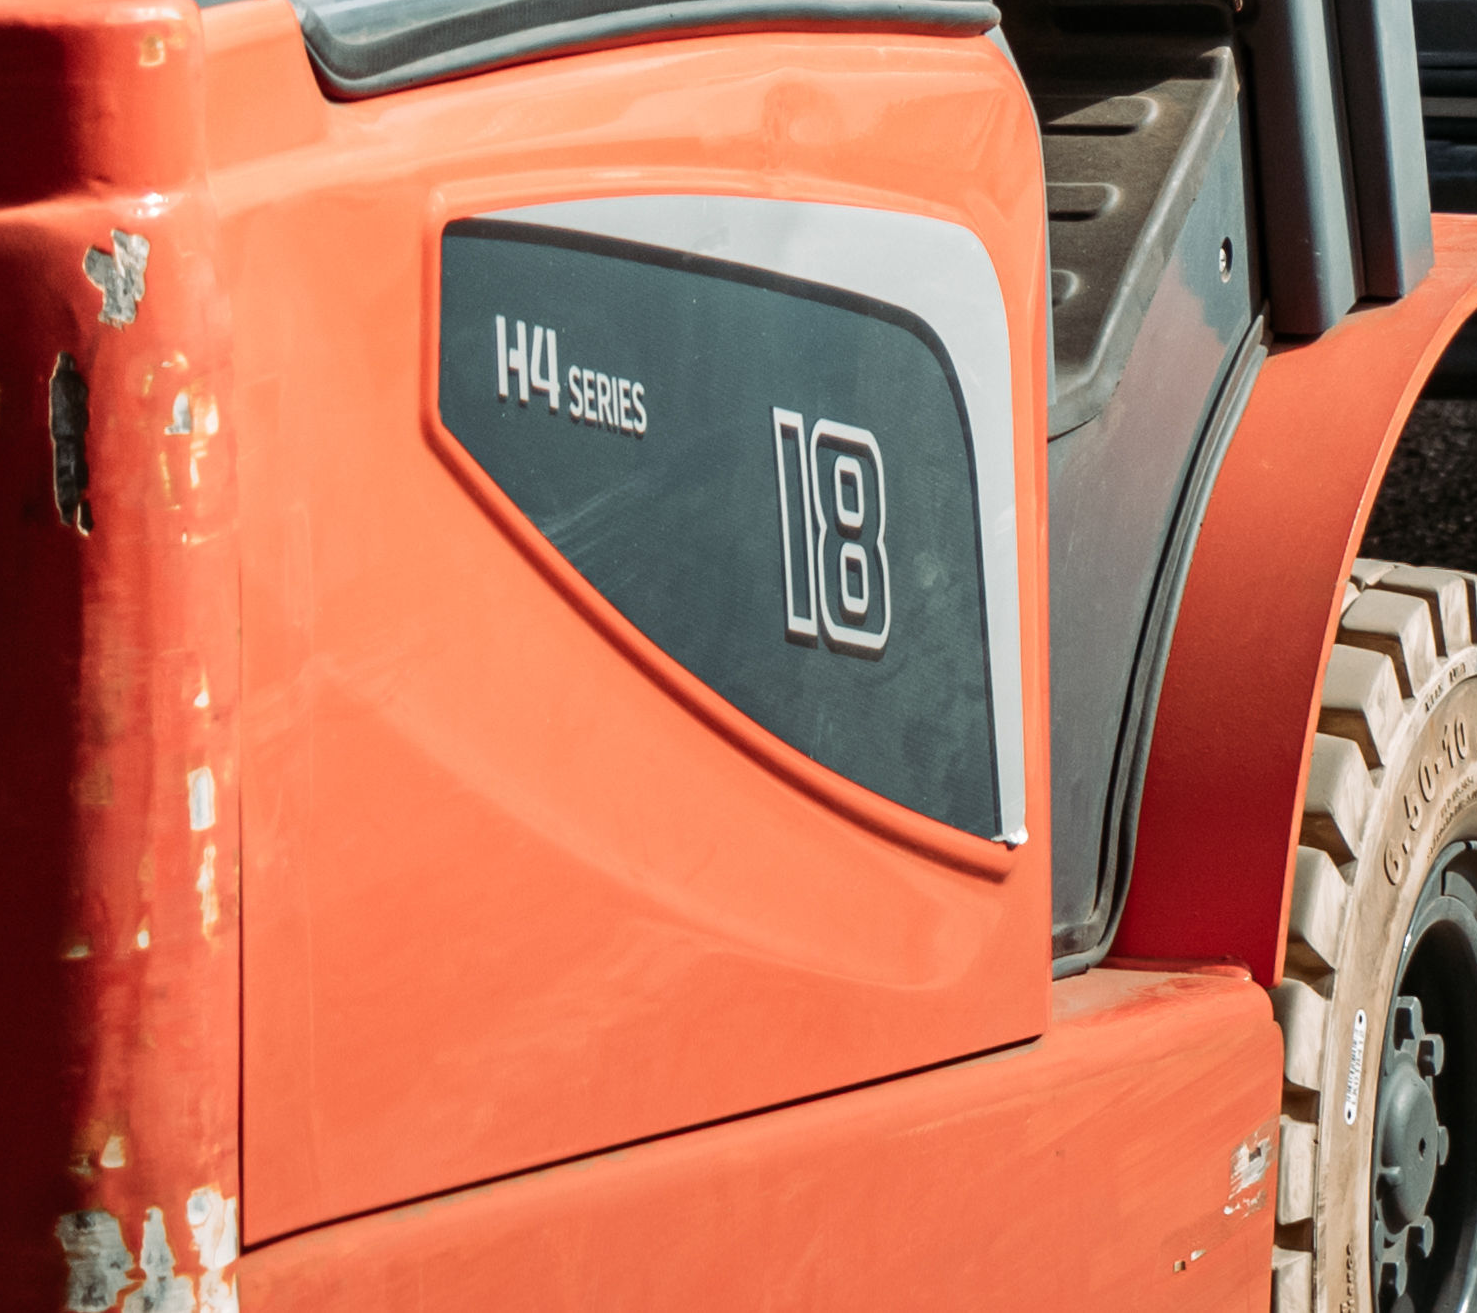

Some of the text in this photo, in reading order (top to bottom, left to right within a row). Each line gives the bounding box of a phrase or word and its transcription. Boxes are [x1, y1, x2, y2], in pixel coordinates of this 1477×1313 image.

[495, 315, 647, 433] H4 SERIES
[772, 406, 891, 653] 18
